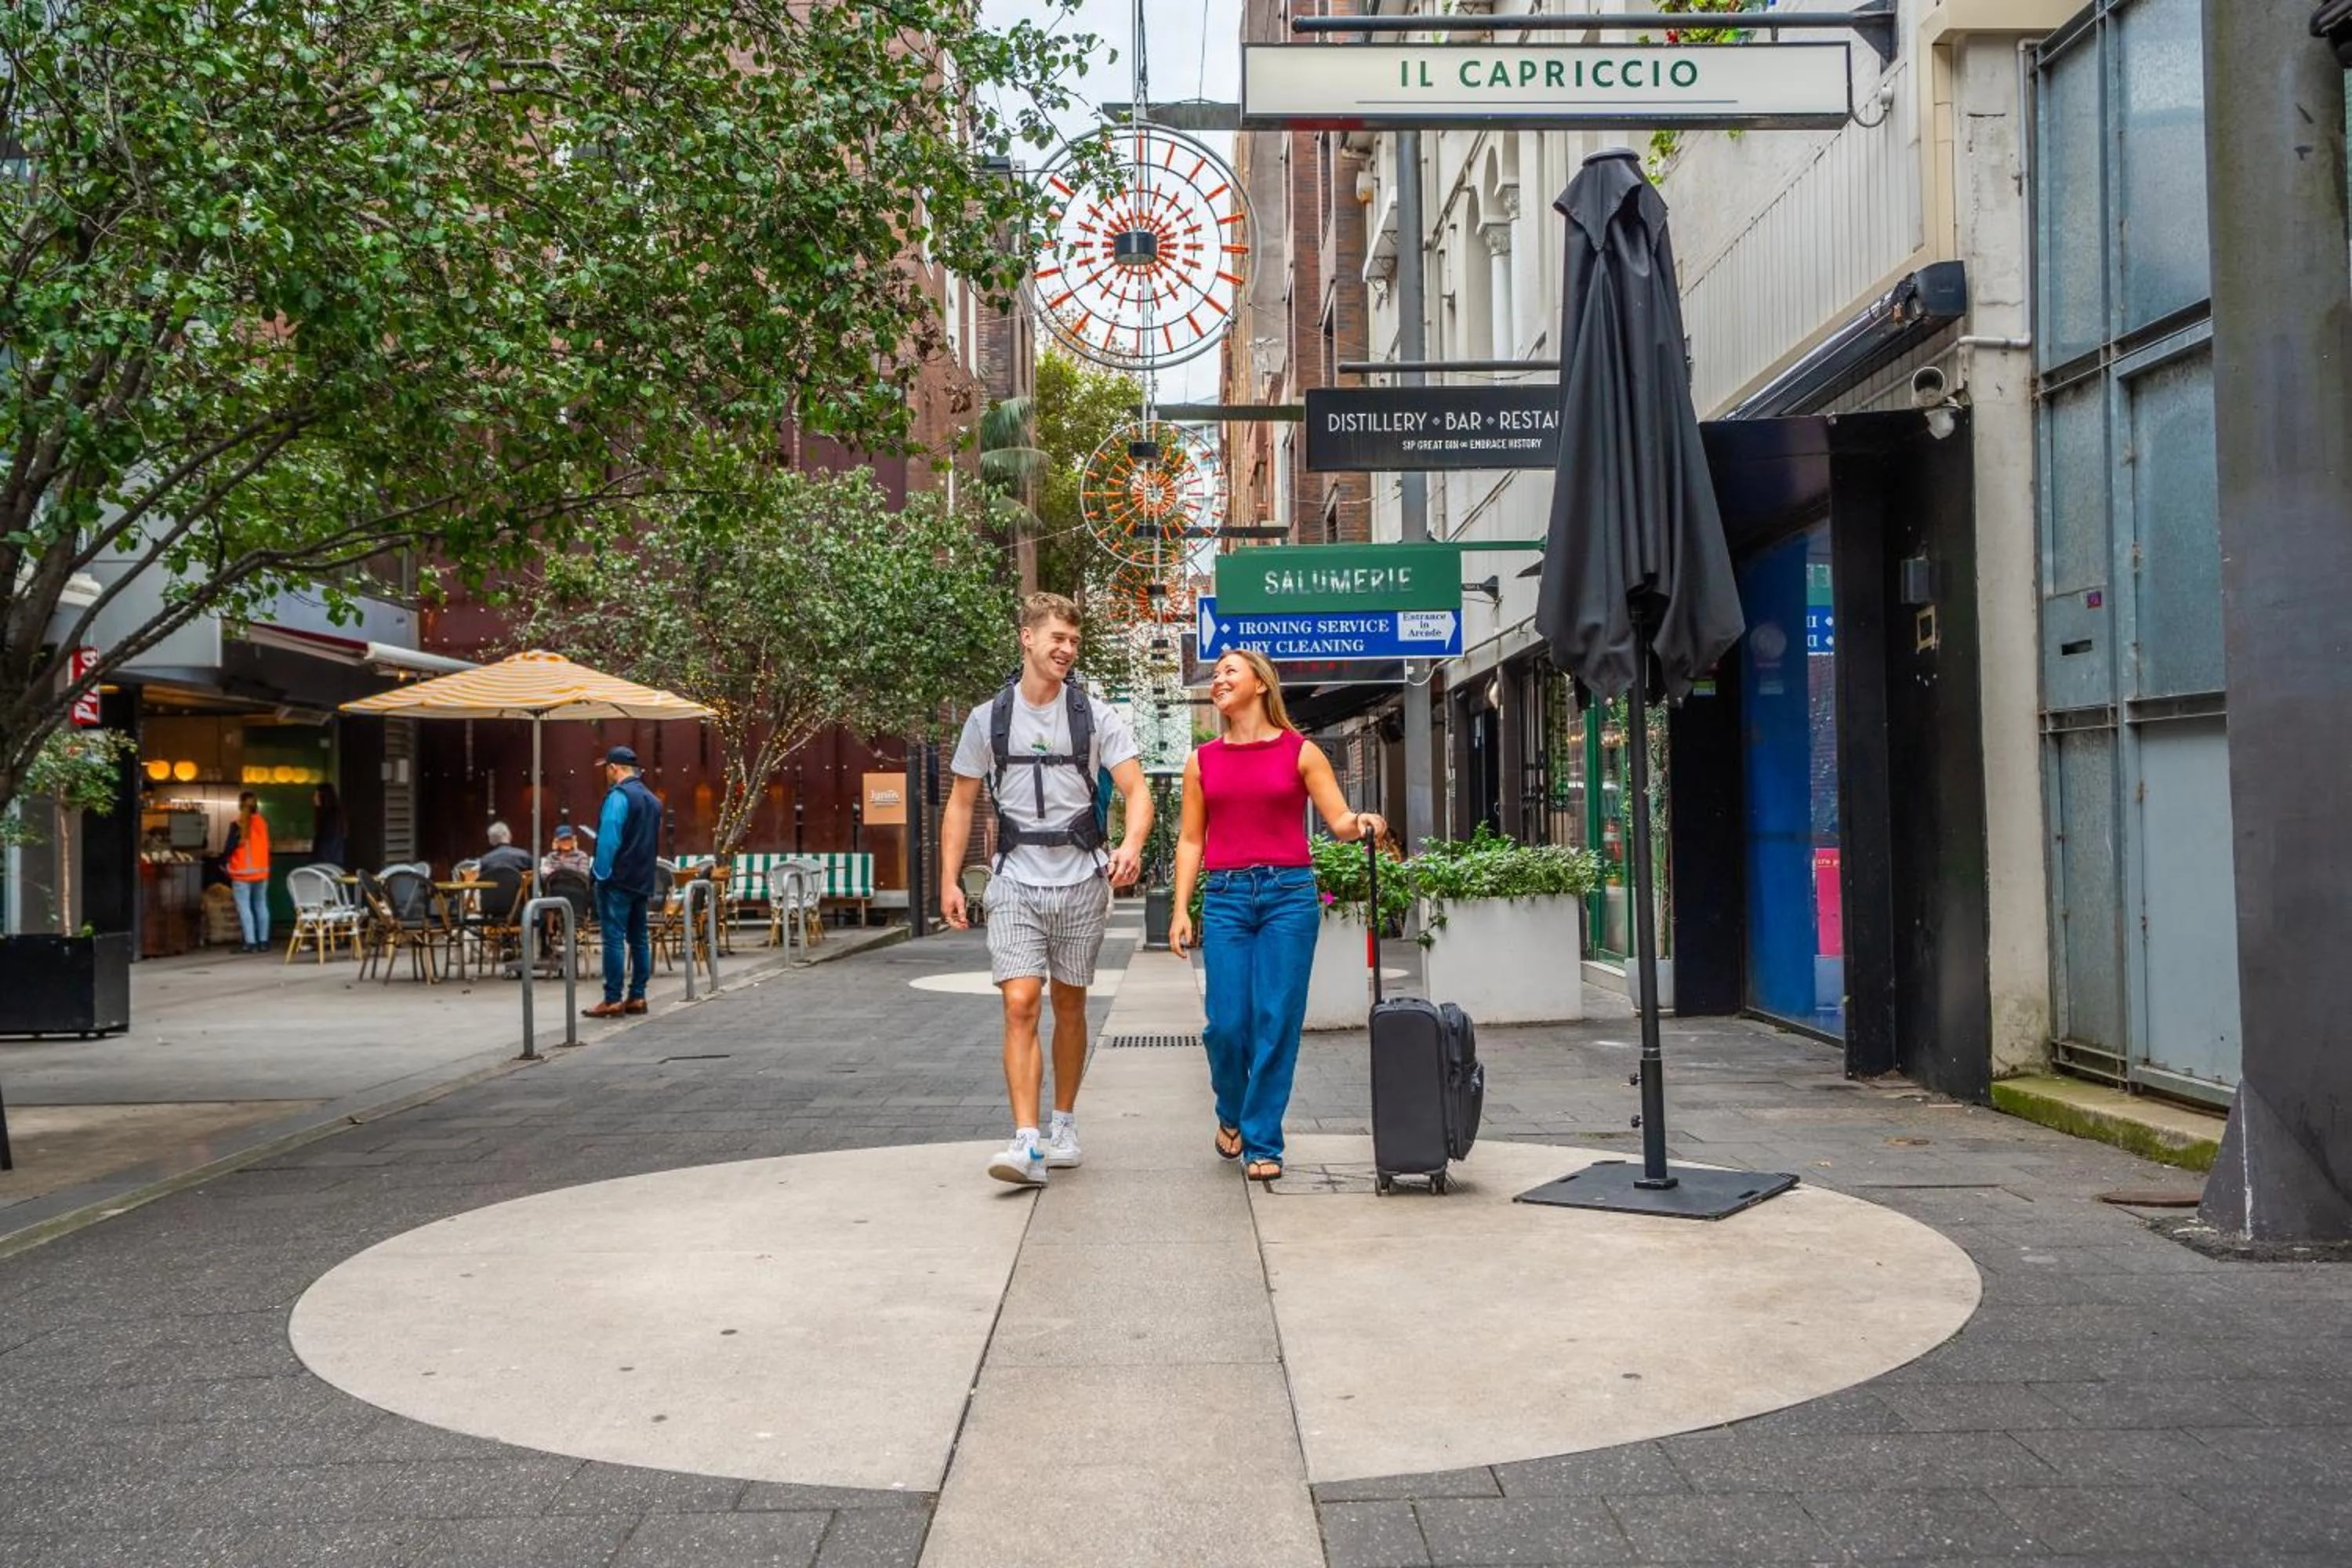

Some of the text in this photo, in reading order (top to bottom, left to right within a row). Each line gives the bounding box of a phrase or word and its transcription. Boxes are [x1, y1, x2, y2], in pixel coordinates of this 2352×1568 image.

[1400, 60, 1698, 88] IL CAPRICCIO
[1328, 412, 1427, 432] DISTILLERY
[1445, 411, 1481, 430] BAR
[1403, 440, 1416, 451] SIP
[1417, 440, 1443, 450] GREAT
[1470, 439, 1506, 450] EMBRACE
[1508, 438, 1542, 449] HISTORY
[1265, 567, 1414, 595] SALUMERIE
[1403, 612, 1446, 622] Entrance
[1239, 619, 1389, 635] IRONING SERVICE
[1408, 629, 1442, 637] Arcade
[1240, 639, 1364, 654] DRY CLEANING
